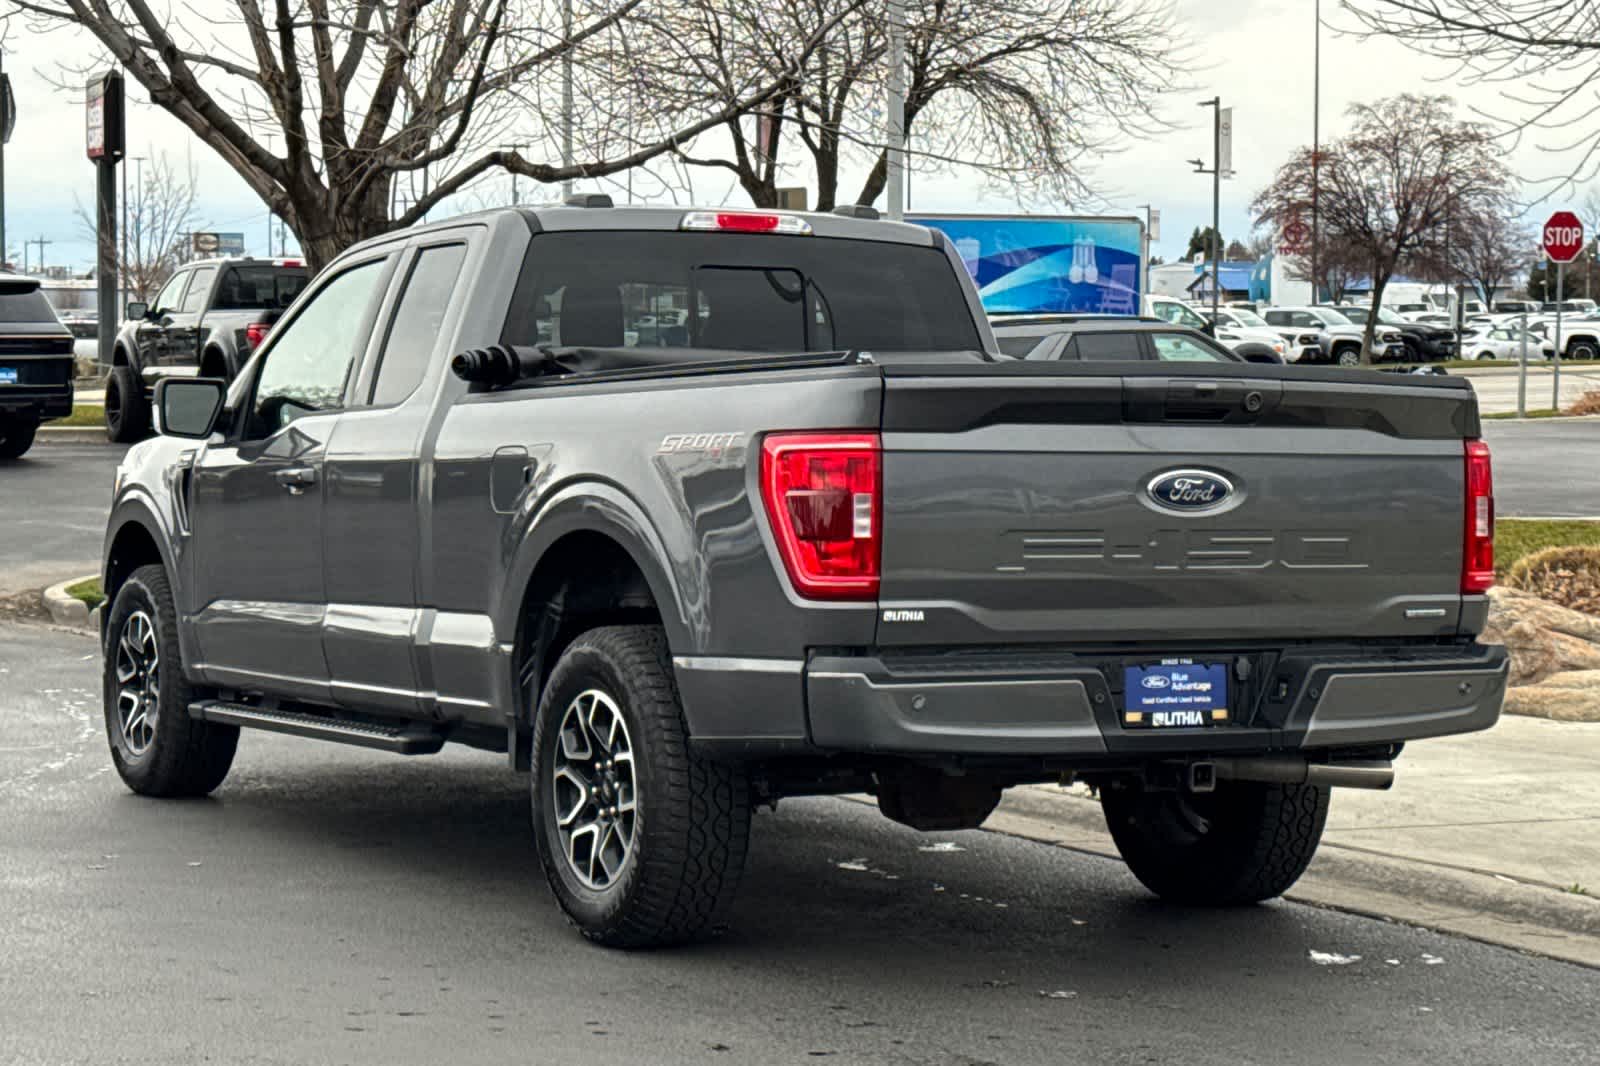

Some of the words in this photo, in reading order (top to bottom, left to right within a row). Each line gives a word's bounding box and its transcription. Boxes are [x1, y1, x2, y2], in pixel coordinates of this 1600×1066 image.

[1545, 227, 1581, 246] STOP
[656, 431, 745, 455] SPORT
[1169, 478, 1215, 501] Ford
[997, 529, 1368, 570] F-150
[892, 610, 925, 621] LITHIA
[1171, 672, 1188, 681] Blue
[1165, 711, 1203, 726] LITHIA
